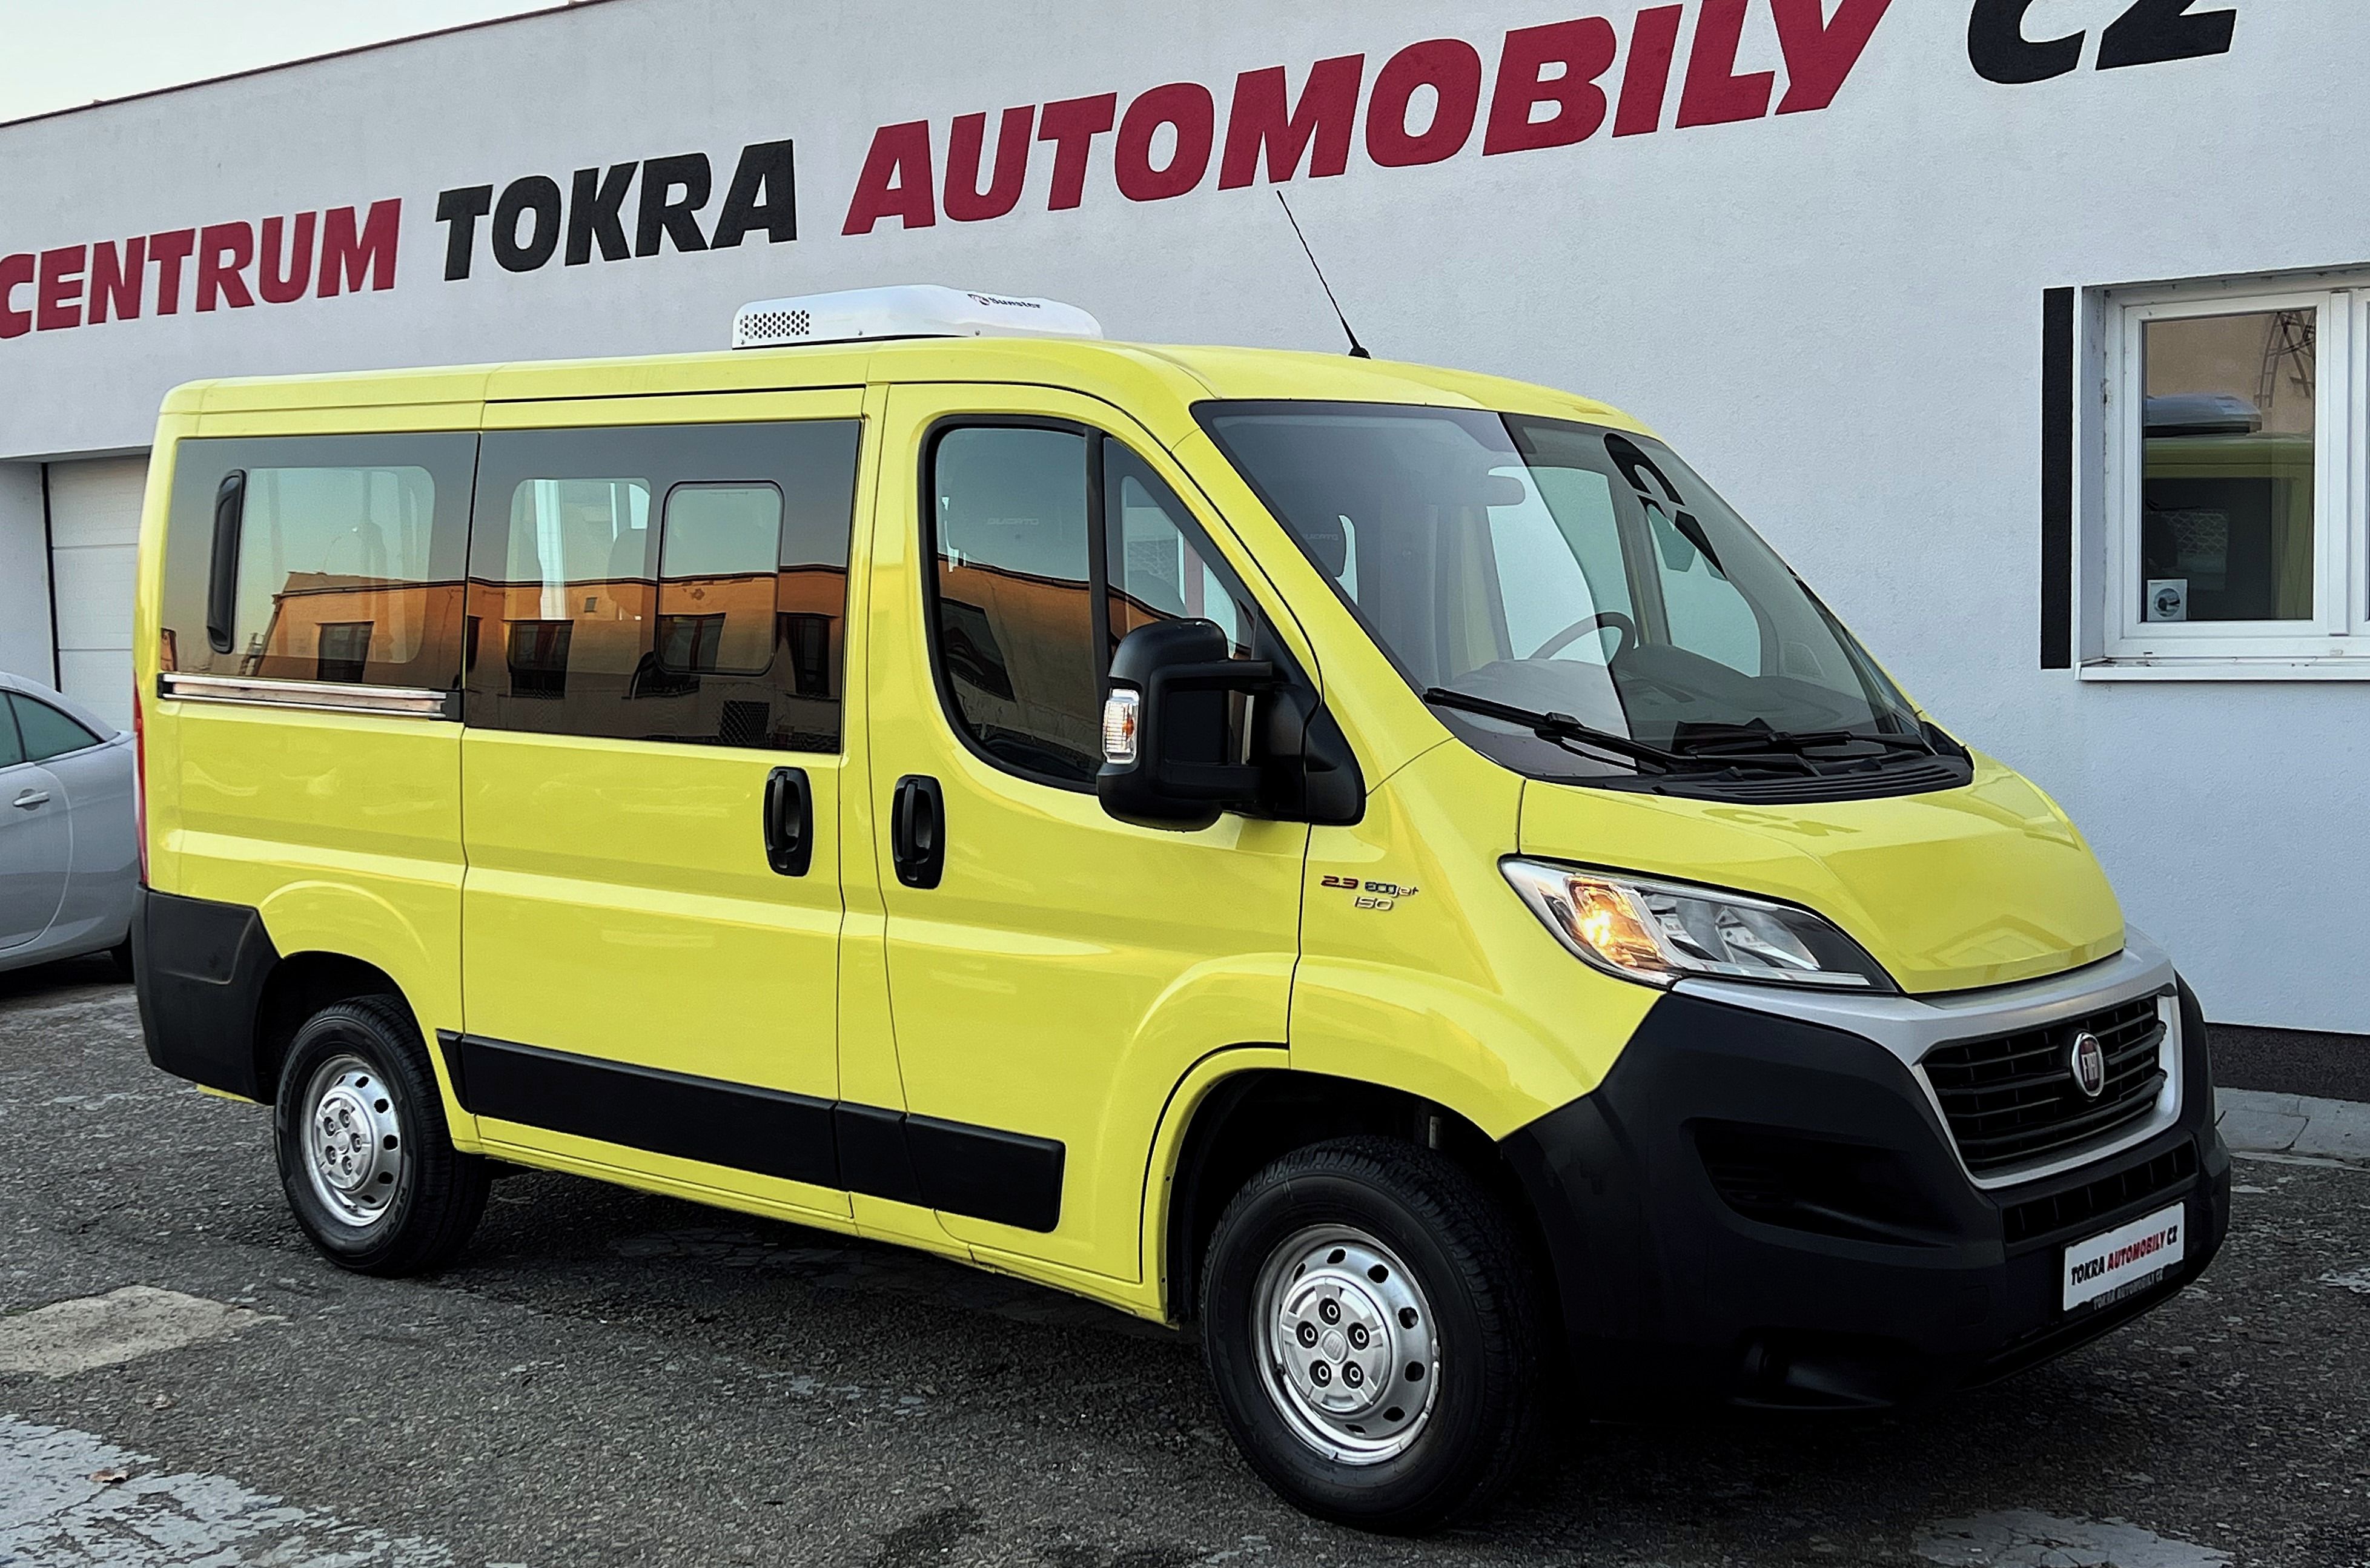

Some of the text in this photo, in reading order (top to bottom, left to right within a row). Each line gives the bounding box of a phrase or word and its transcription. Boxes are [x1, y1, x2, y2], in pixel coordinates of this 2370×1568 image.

[0, 199, 400, 338] CENTRUM
[436, 139, 796, 281] TOKRA
[842, 0, 1892, 235] AUTOMOBILY
[2071, 1224, 2179, 1286] TOKRA AUTOMOBILY CZ
